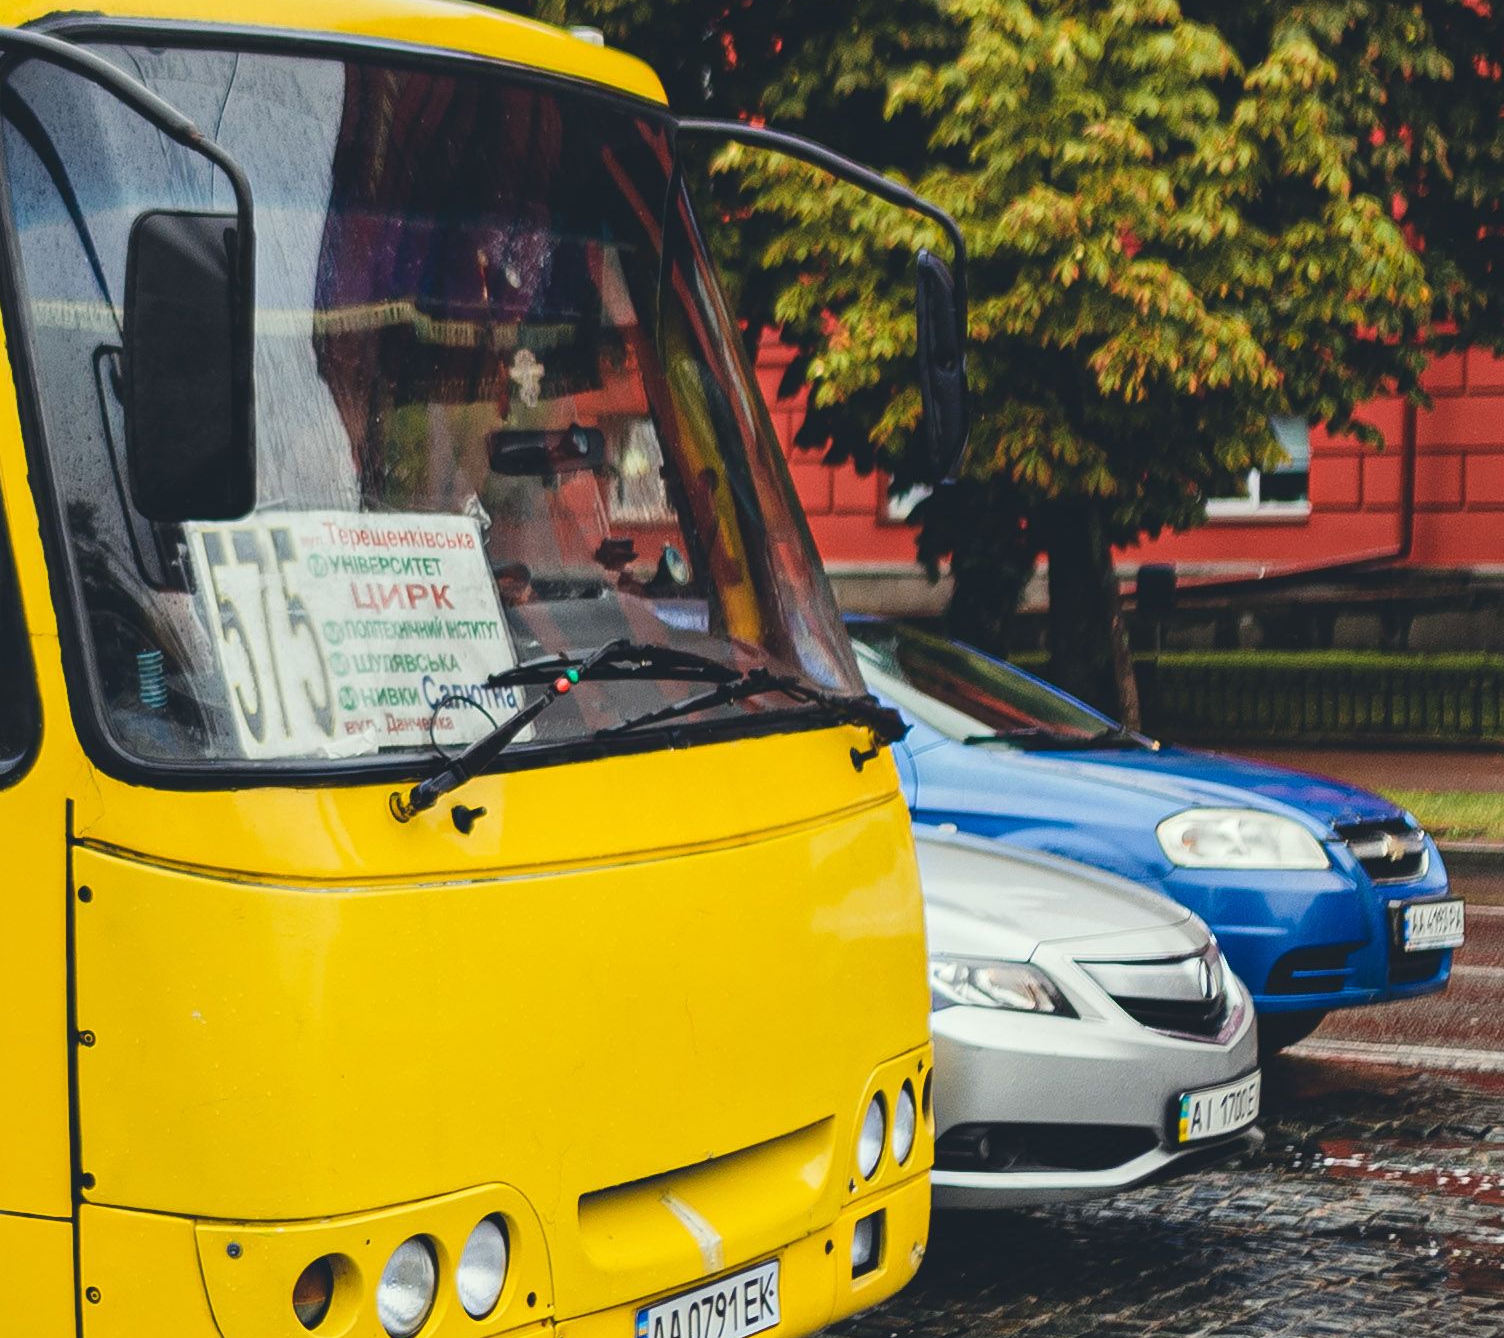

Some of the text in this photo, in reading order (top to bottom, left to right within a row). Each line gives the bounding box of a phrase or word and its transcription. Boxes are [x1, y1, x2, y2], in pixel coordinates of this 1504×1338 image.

[323, 522, 476, 551] Терещенківська
[328, 556, 442, 577] УНІВЕРСИТЕТ
[350, 581, 456, 612] ЦИРК
[202, 528, 335, 744] 575
[353, 653, 463, 674] ШУЛЯВСЬКА
[362, 686, 420, 708] НИВКИ
